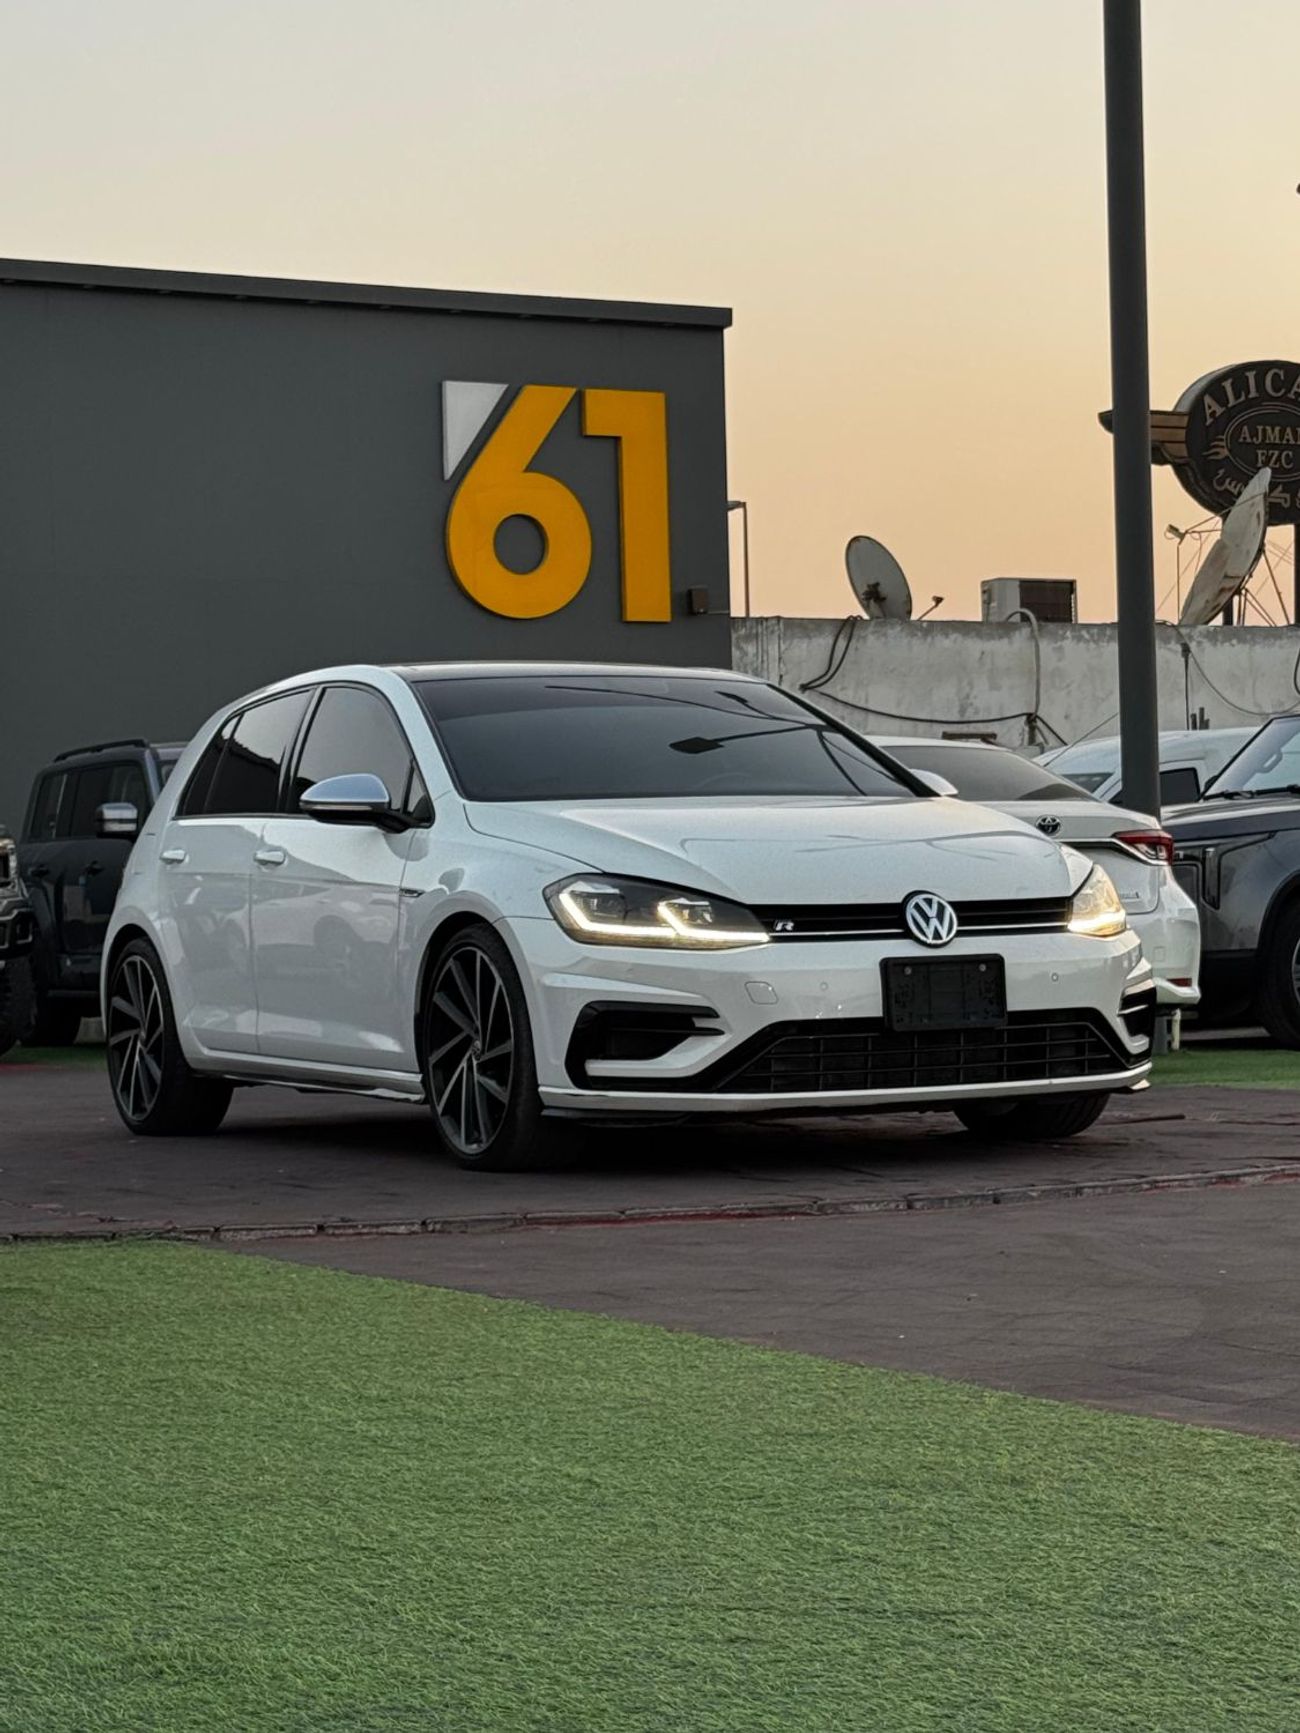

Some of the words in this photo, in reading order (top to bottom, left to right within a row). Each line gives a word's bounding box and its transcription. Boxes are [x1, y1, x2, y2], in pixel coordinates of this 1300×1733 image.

[1239, 425, 1300, 445] AJMA
[1256, 449, 1294, 468] FZC
[446, 384, 671, 621] 61
